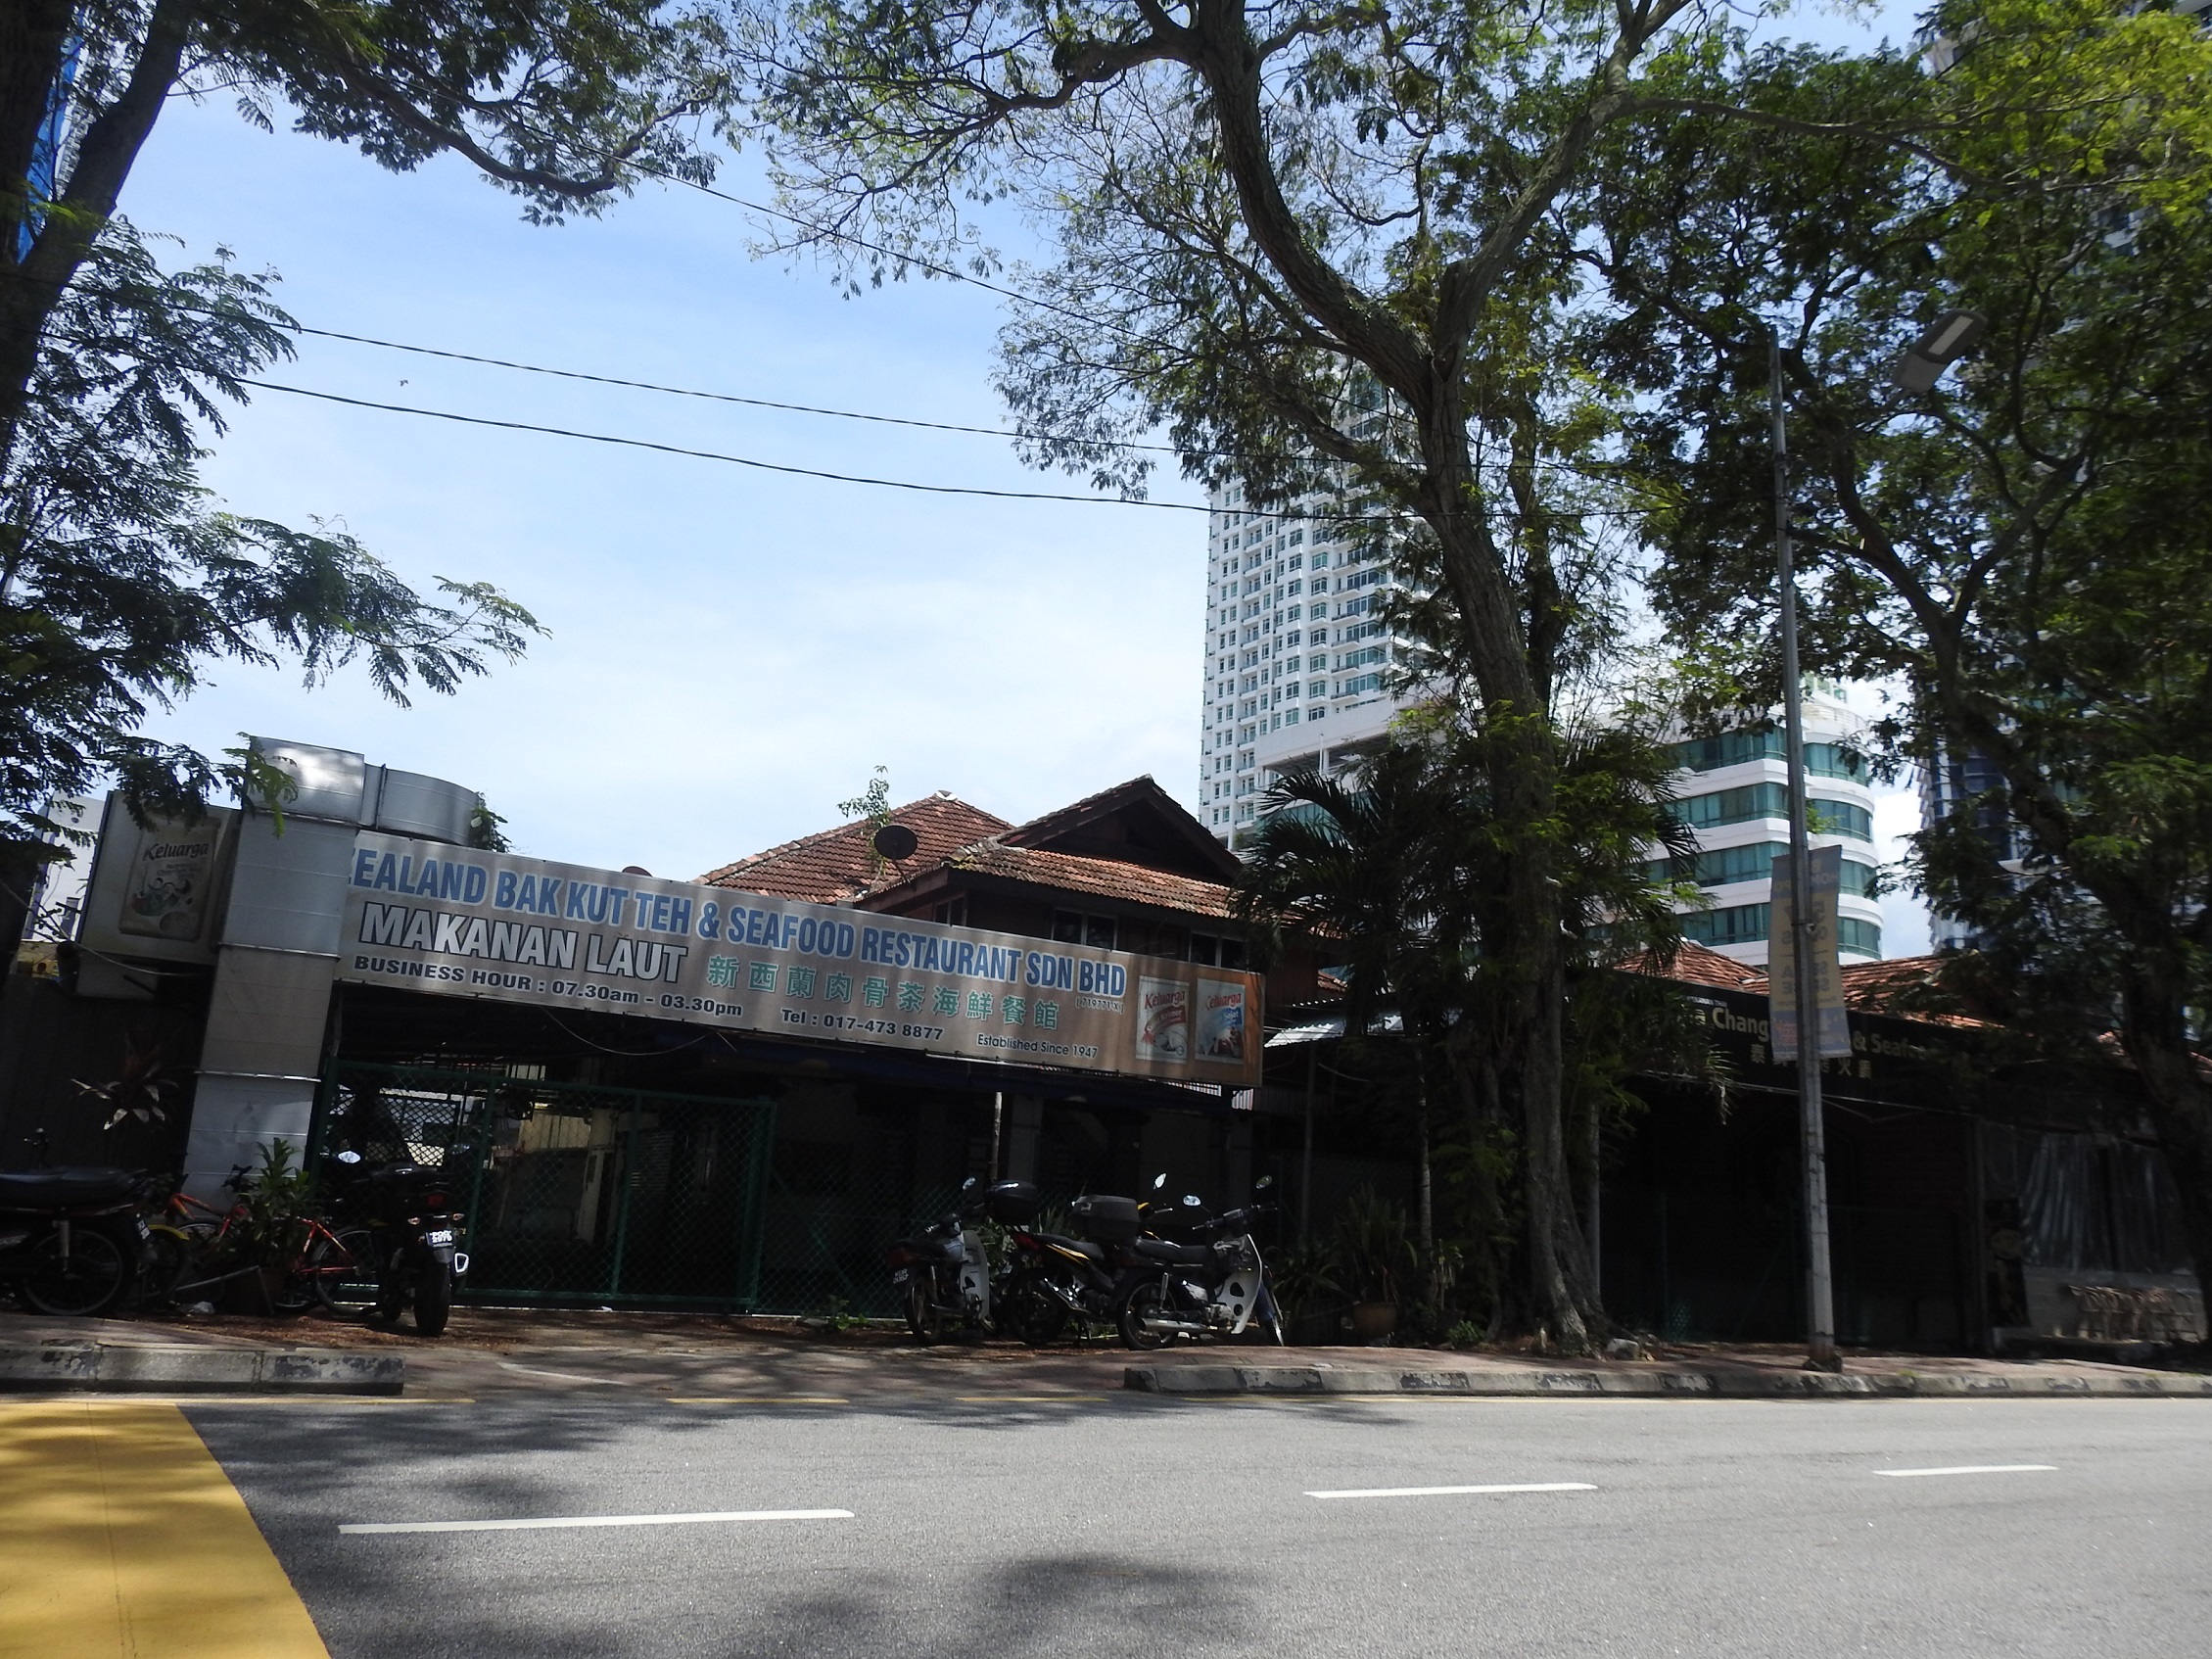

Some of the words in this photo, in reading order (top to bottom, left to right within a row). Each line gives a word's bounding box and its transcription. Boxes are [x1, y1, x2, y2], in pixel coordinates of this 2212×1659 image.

[142, 843, 209, 861] Keluarga
[349, 848, 487, 903] EALAND
[494, 871, 562, 916] BAK
[566, 882, 629, 924] KUT
[635, 892, 691, 934] TEH
[698, 902, 721, 939] &
[729, 907, 855, 958] SEAFOOD
[860, 928, 1021, 981] RESTAURANT
[1026, 953, 1073, 990] SDN
[1079, 961, 1126, 997] BHD
[358, 901, 579, 970] MAKANAN
[585, 933, 688, 983] LAUT
[354, 956, 465, 982] BUSINESS
[472, 970, 532, 990] HOUR
[552, 980, 638, 1003] 07.30am
[660, 995, 742, 1017] 03.30pm
[782, 1009, 805, 1024] Tel
[824, 1015, 896, 1035] 017-473
[902, 1024, 944, 1040] 8877
[1712, 1007, 1769, 1043] Chang
[977, 1033, 1038, 1052] Established
[1040, 1041, 1069, 1056] Since
[1072, 1045, 1098, 1059] 1947
